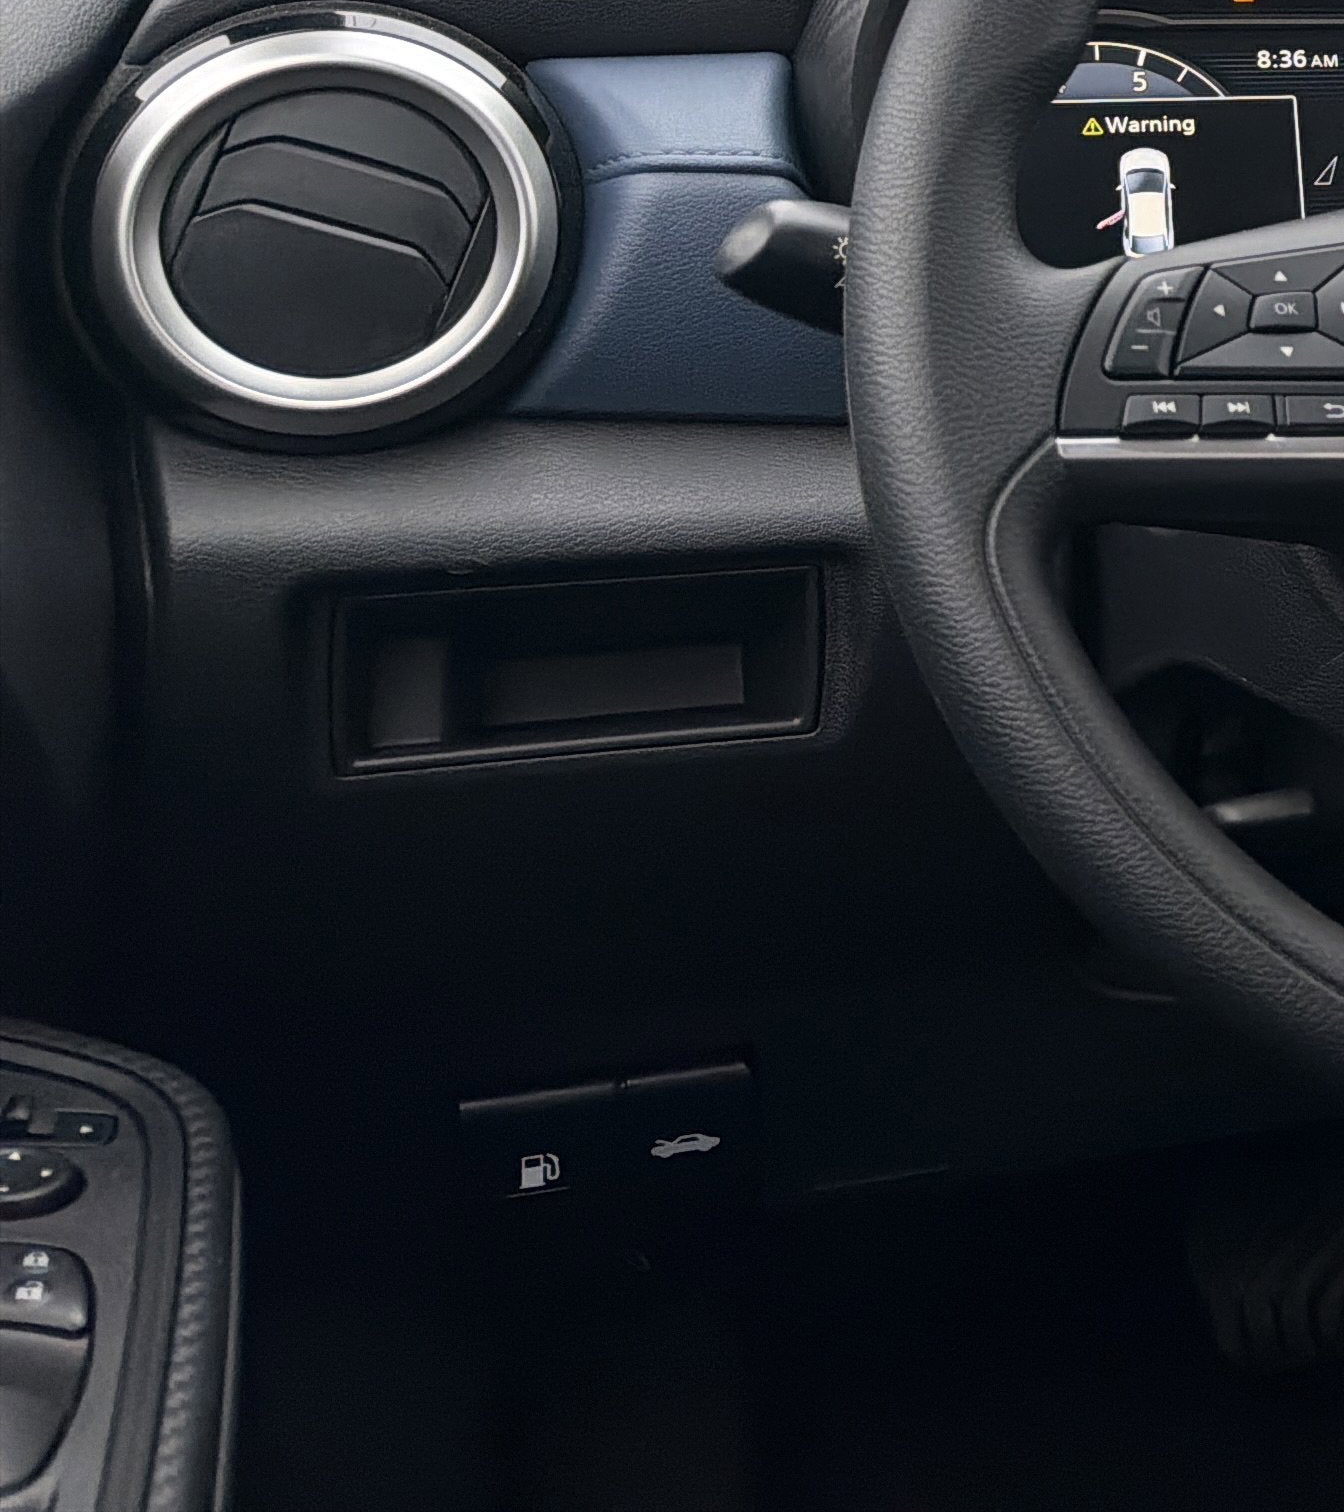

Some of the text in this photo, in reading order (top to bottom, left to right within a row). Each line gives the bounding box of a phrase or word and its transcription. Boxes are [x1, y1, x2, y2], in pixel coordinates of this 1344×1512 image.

[1257, 48, 1307, 69] 8:36
[1311, 53, 1339, 68] AM
[1132, 71, 1148, 92] 5
[1105, 116, 1196, 136] Warning
[1274, 302, 1299, 315] OK
